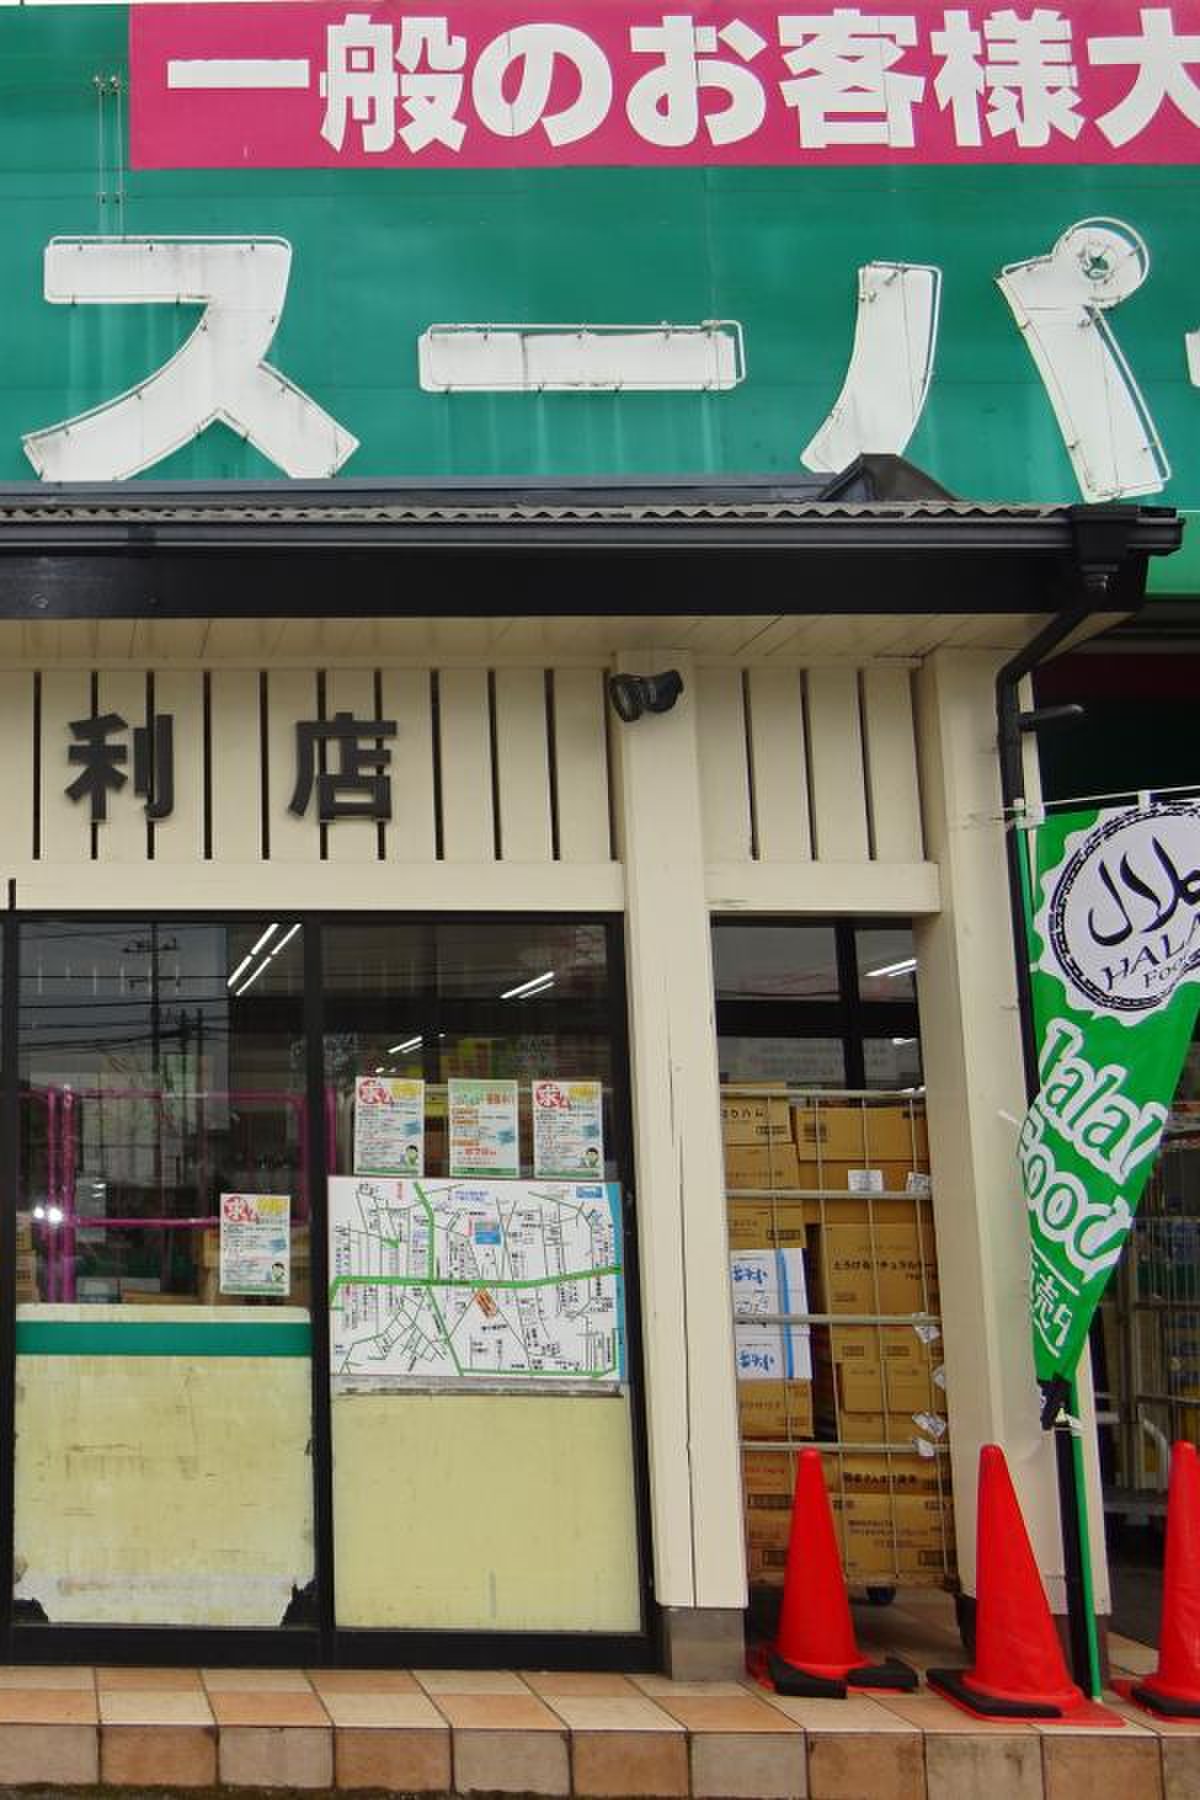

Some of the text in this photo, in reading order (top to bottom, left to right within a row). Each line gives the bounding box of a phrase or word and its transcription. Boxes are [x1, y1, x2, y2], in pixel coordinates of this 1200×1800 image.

[166, 8, 1200, 154] 一般のお客様大
